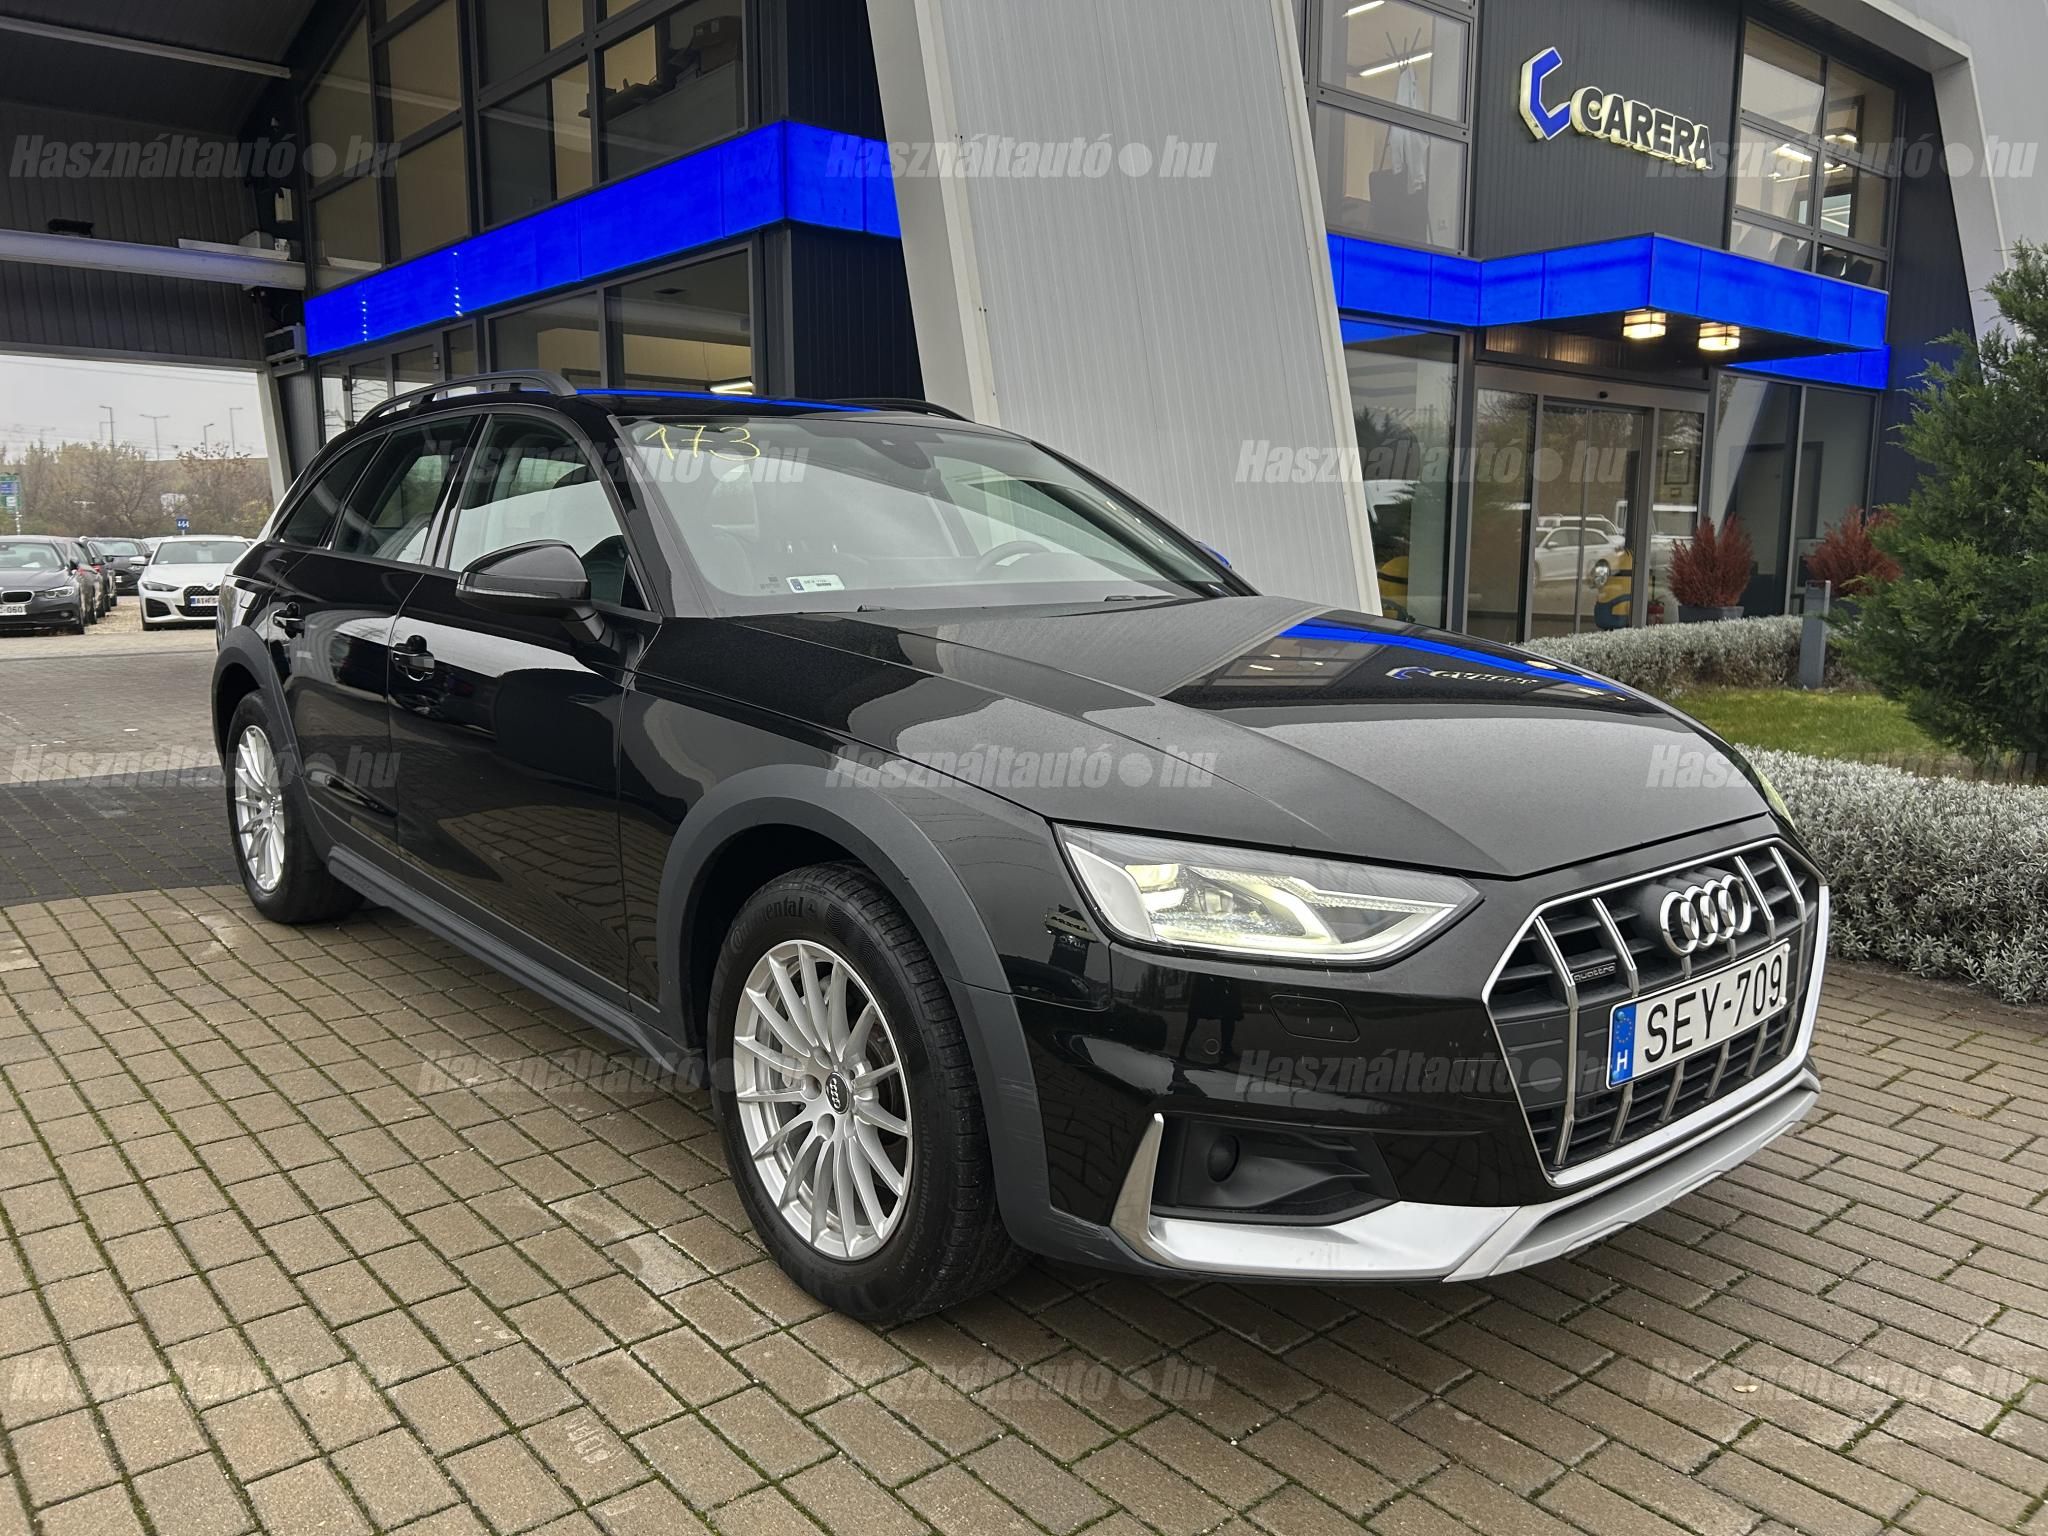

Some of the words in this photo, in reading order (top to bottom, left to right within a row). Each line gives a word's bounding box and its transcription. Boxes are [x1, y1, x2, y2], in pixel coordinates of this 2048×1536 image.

[1570, 86, 1713, 170] CARERA
[645, 424, 761, 461] 173
[730, 896, 804, 955] Connental
[1573, 963, 1616, 982] quattro
[1616, 1050, 1628, 1072] H
[1644, 954, 1783, 1063] SEY-709
